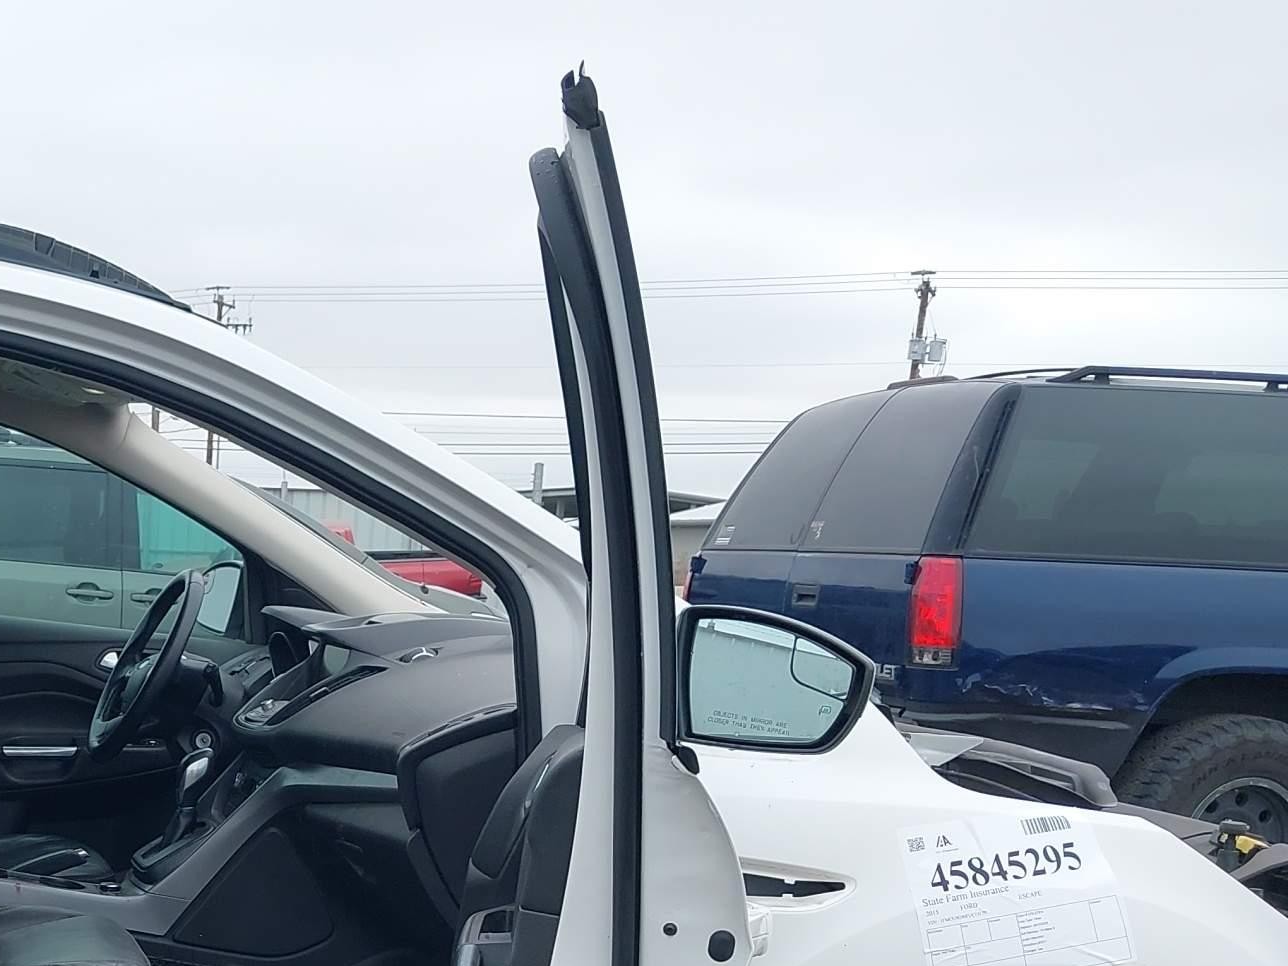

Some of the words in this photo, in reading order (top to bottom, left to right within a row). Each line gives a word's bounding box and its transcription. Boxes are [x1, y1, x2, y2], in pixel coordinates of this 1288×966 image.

[707, 716, 729, 726] CLOSER
[732, 720, 747, 729] THAN
[767, 727, 790, 736] APPEAR
[713, 710, 738, 720] OBJECTS
[750, 717, 773, 725] MIRROR
[775, 721, 788, 729] ARE
[931, 842, 1082, 892] 45845295
[922, 897, 944, 908] State
[946, 893, 968, 904] Farm
[970, 885, 1009, 900] Insurance
